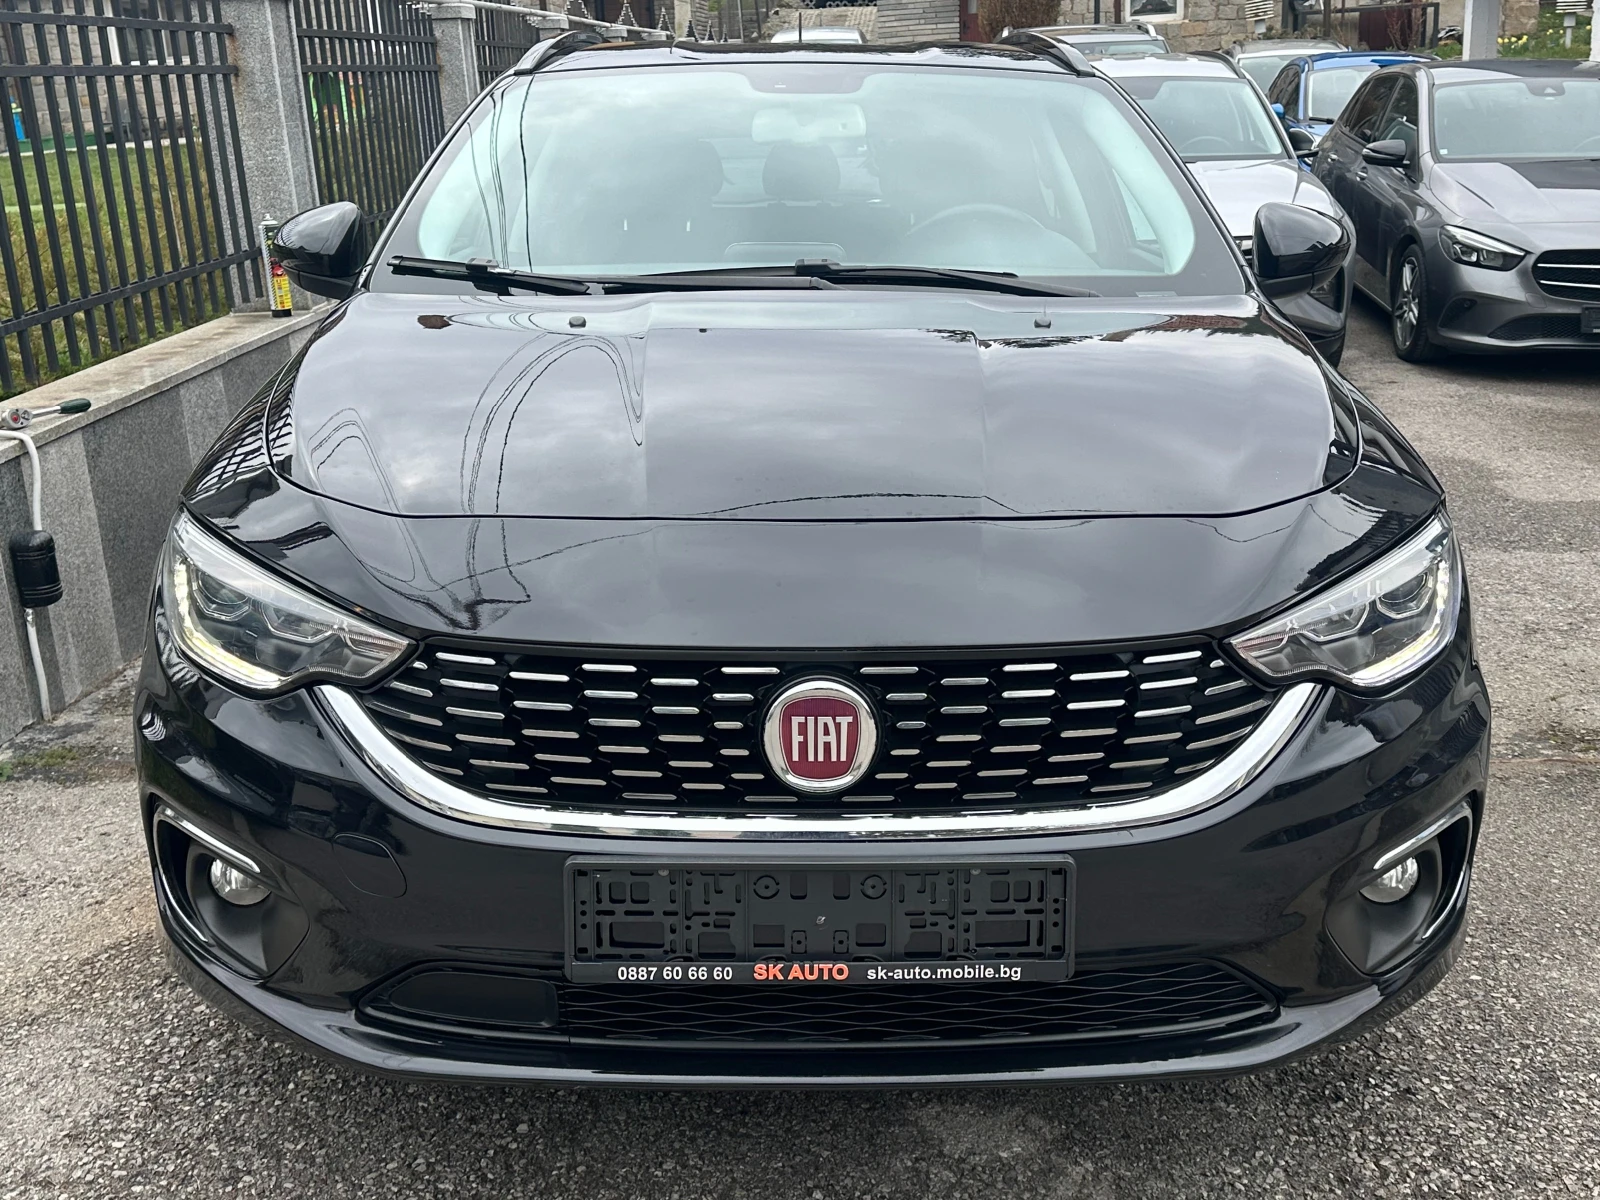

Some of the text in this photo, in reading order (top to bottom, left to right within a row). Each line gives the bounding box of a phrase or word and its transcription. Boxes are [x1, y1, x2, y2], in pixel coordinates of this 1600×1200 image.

[791, 716, 853, 762] FIAT
[617, 963, 1022, 981] 0887 60 66 60 SK AUTO sk-auto.mobile.bg
